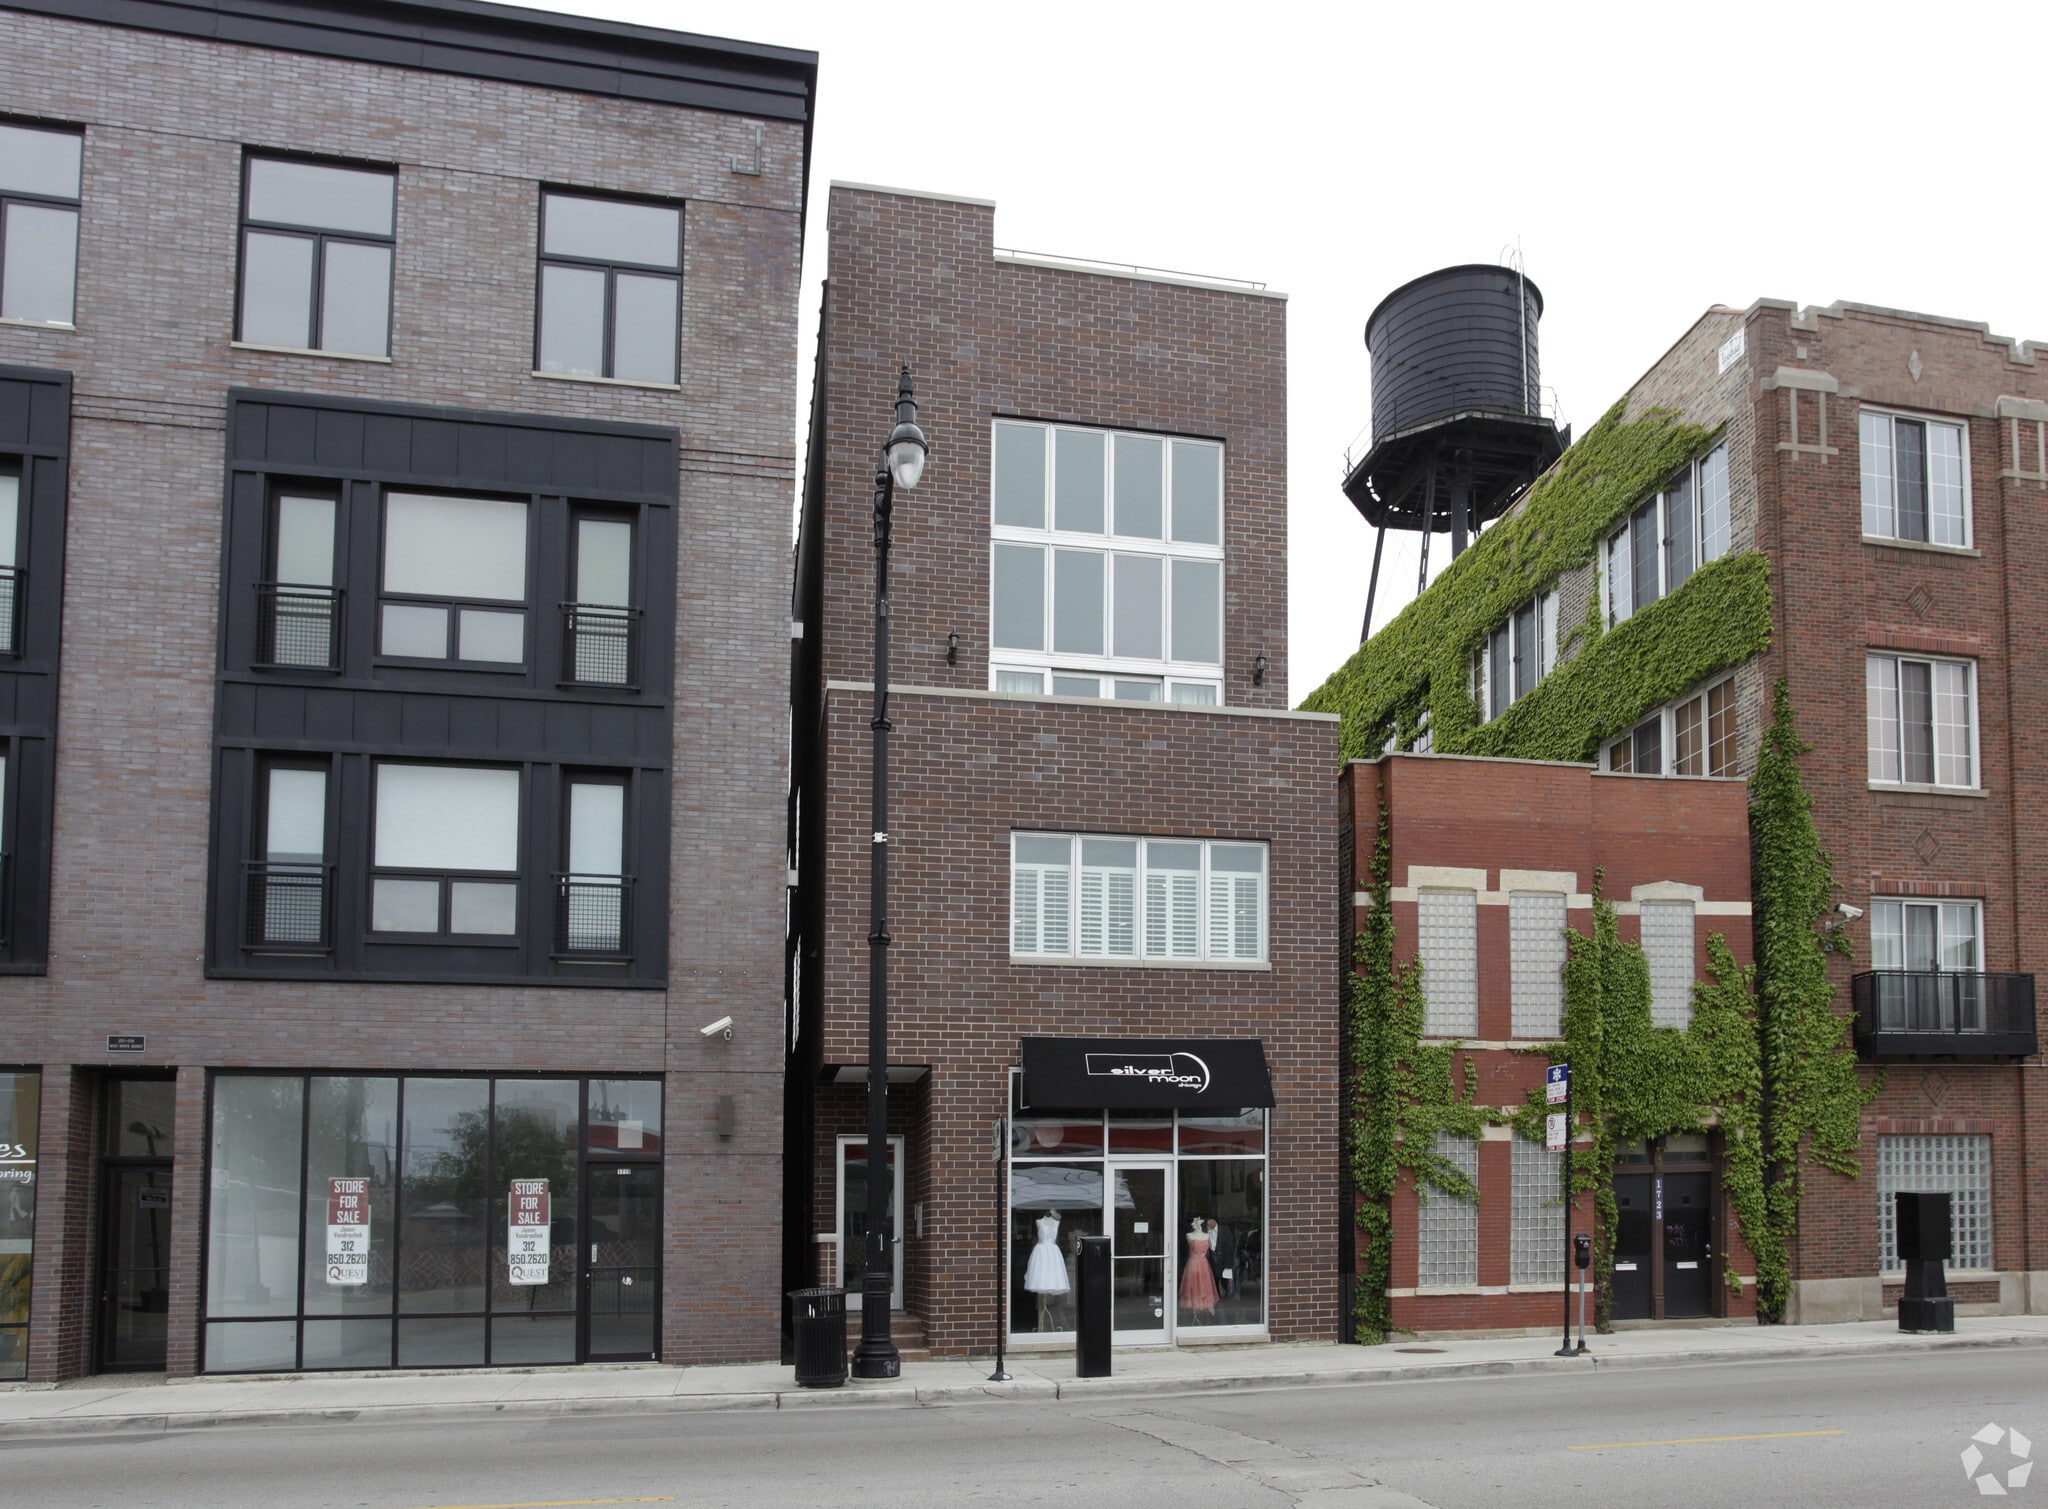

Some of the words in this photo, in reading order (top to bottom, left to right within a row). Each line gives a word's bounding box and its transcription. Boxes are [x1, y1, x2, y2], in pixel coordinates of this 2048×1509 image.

[1111, 1065, 1172, 1075] silver
[1149, 1075, 1201, 1083] moon
[334, 1180, 365, 1193] STORE
[515, 1182, 544, 1195] STORE
[340, 1195, 358, 1208] FOR
[520, 1197, 538, 1210] FOR
[337, 1211, 360, 1223] SALE
[518, 1212, 540, 1224] SALE
[341, 1240, 354, 1251] 312
[522, 1241, 535, 1252] 312
[328, 1253, 367, 1264] 850.2620
[510, 1253, 547, 1265] 850.2620
[328, 1266, 366, 1280] QUEST
[511, 1265, 547, 1280] QUEST
